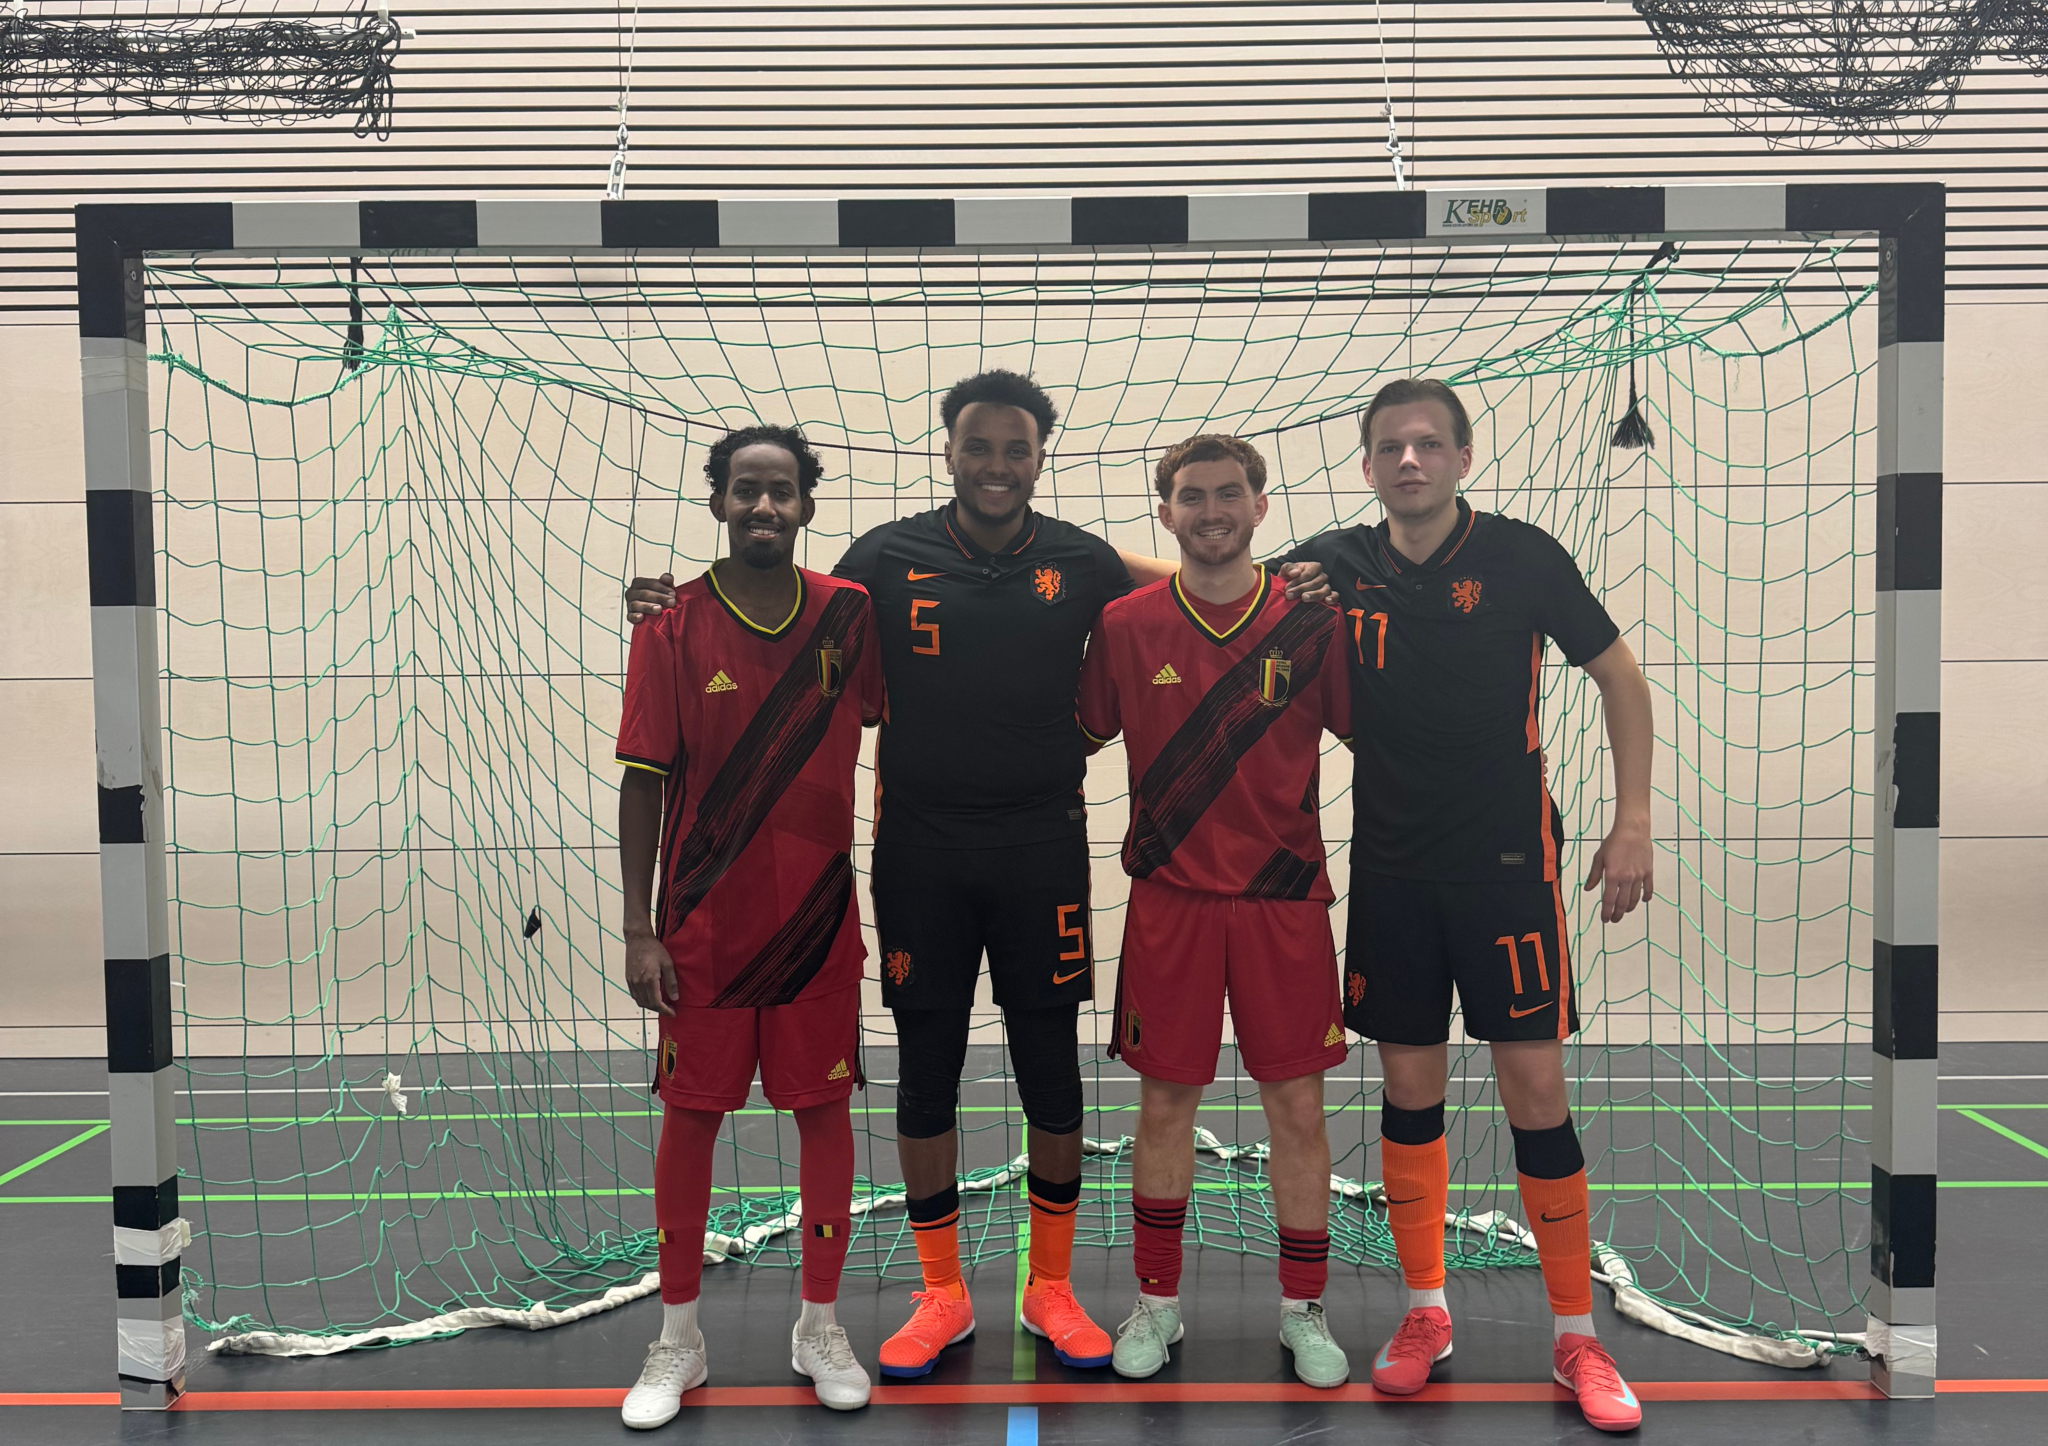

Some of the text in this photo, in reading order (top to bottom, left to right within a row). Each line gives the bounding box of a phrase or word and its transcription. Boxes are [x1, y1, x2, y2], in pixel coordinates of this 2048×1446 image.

[1442, 199, 1508, 224] KEHR
[910, 598, 941, 656] 5
[1346, 607, 1389, 670] 11
[705, 682, 738, 694] adidas
[1152, 676, 1182, 685] adidas
[1056, 903, 1085, 961] 5
[1494, 931, 1550, 995] 11
[1323, 1033, 1346, 1048] adidas
[827, 1069, 851, 1081] adidas
